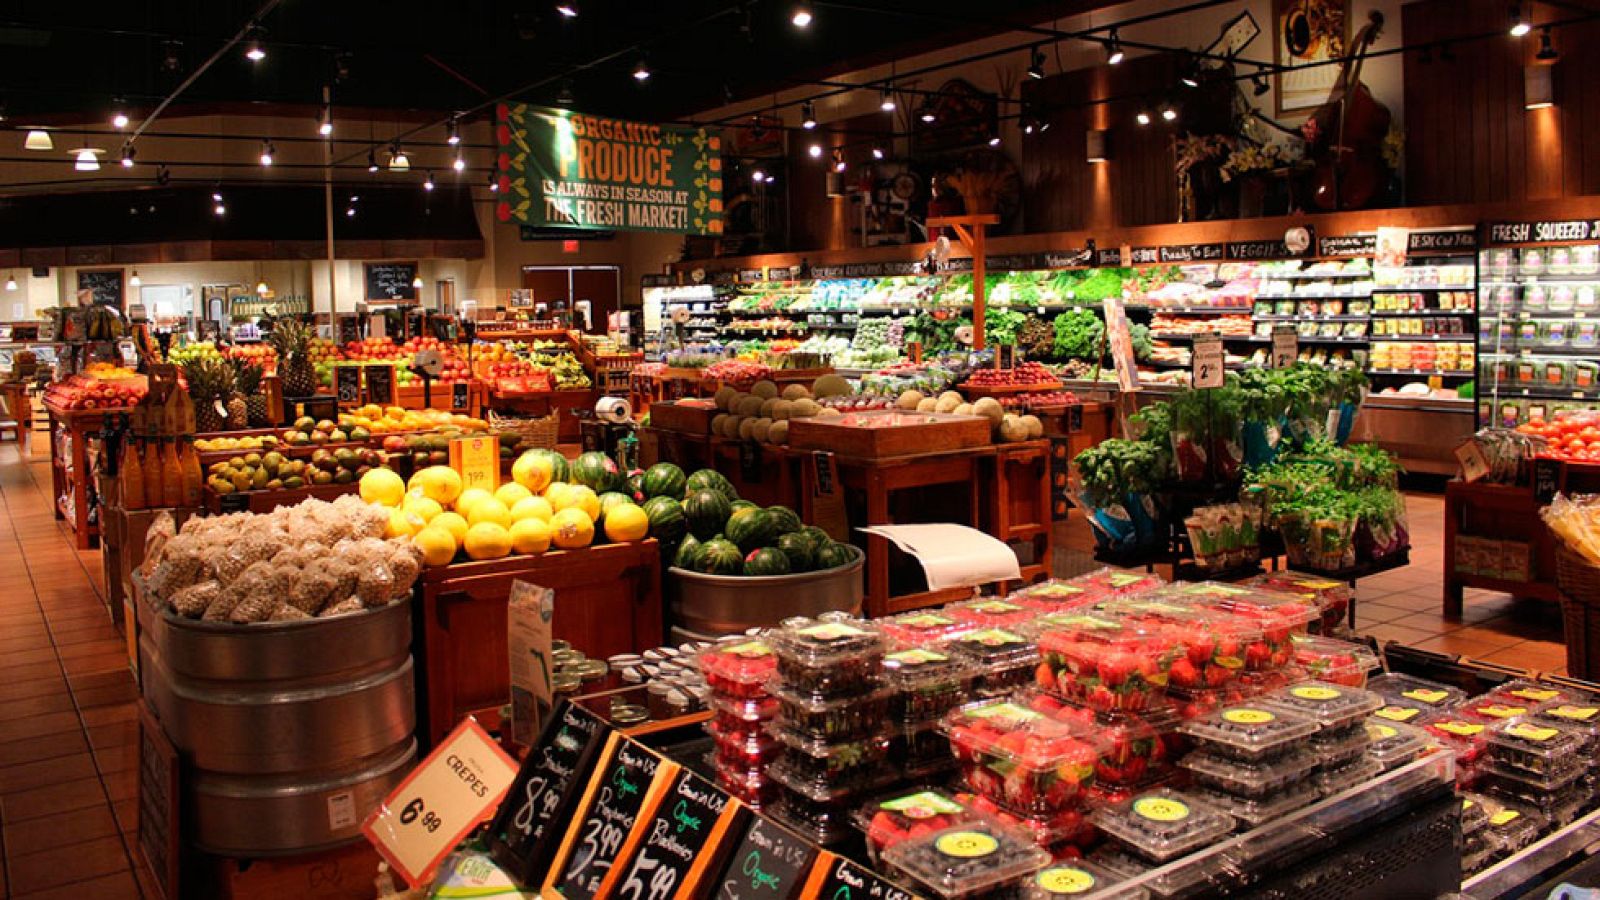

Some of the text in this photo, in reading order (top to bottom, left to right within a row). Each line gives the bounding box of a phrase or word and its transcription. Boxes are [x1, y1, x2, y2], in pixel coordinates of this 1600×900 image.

[570, 113, 661, 146] ORGANIC
[557, 132, 674, 187] PRODUCE
[542, 180, 689, 205] IS ALWAYS IN SEASON AT
[543, 196, 689, 229] THE FRESH MARKET!
[1492, 224, 1531, 241] FRESH
[1534, 222, 1588, 241] SQUEEZED
[446, 754, 488, 797] CREPES
